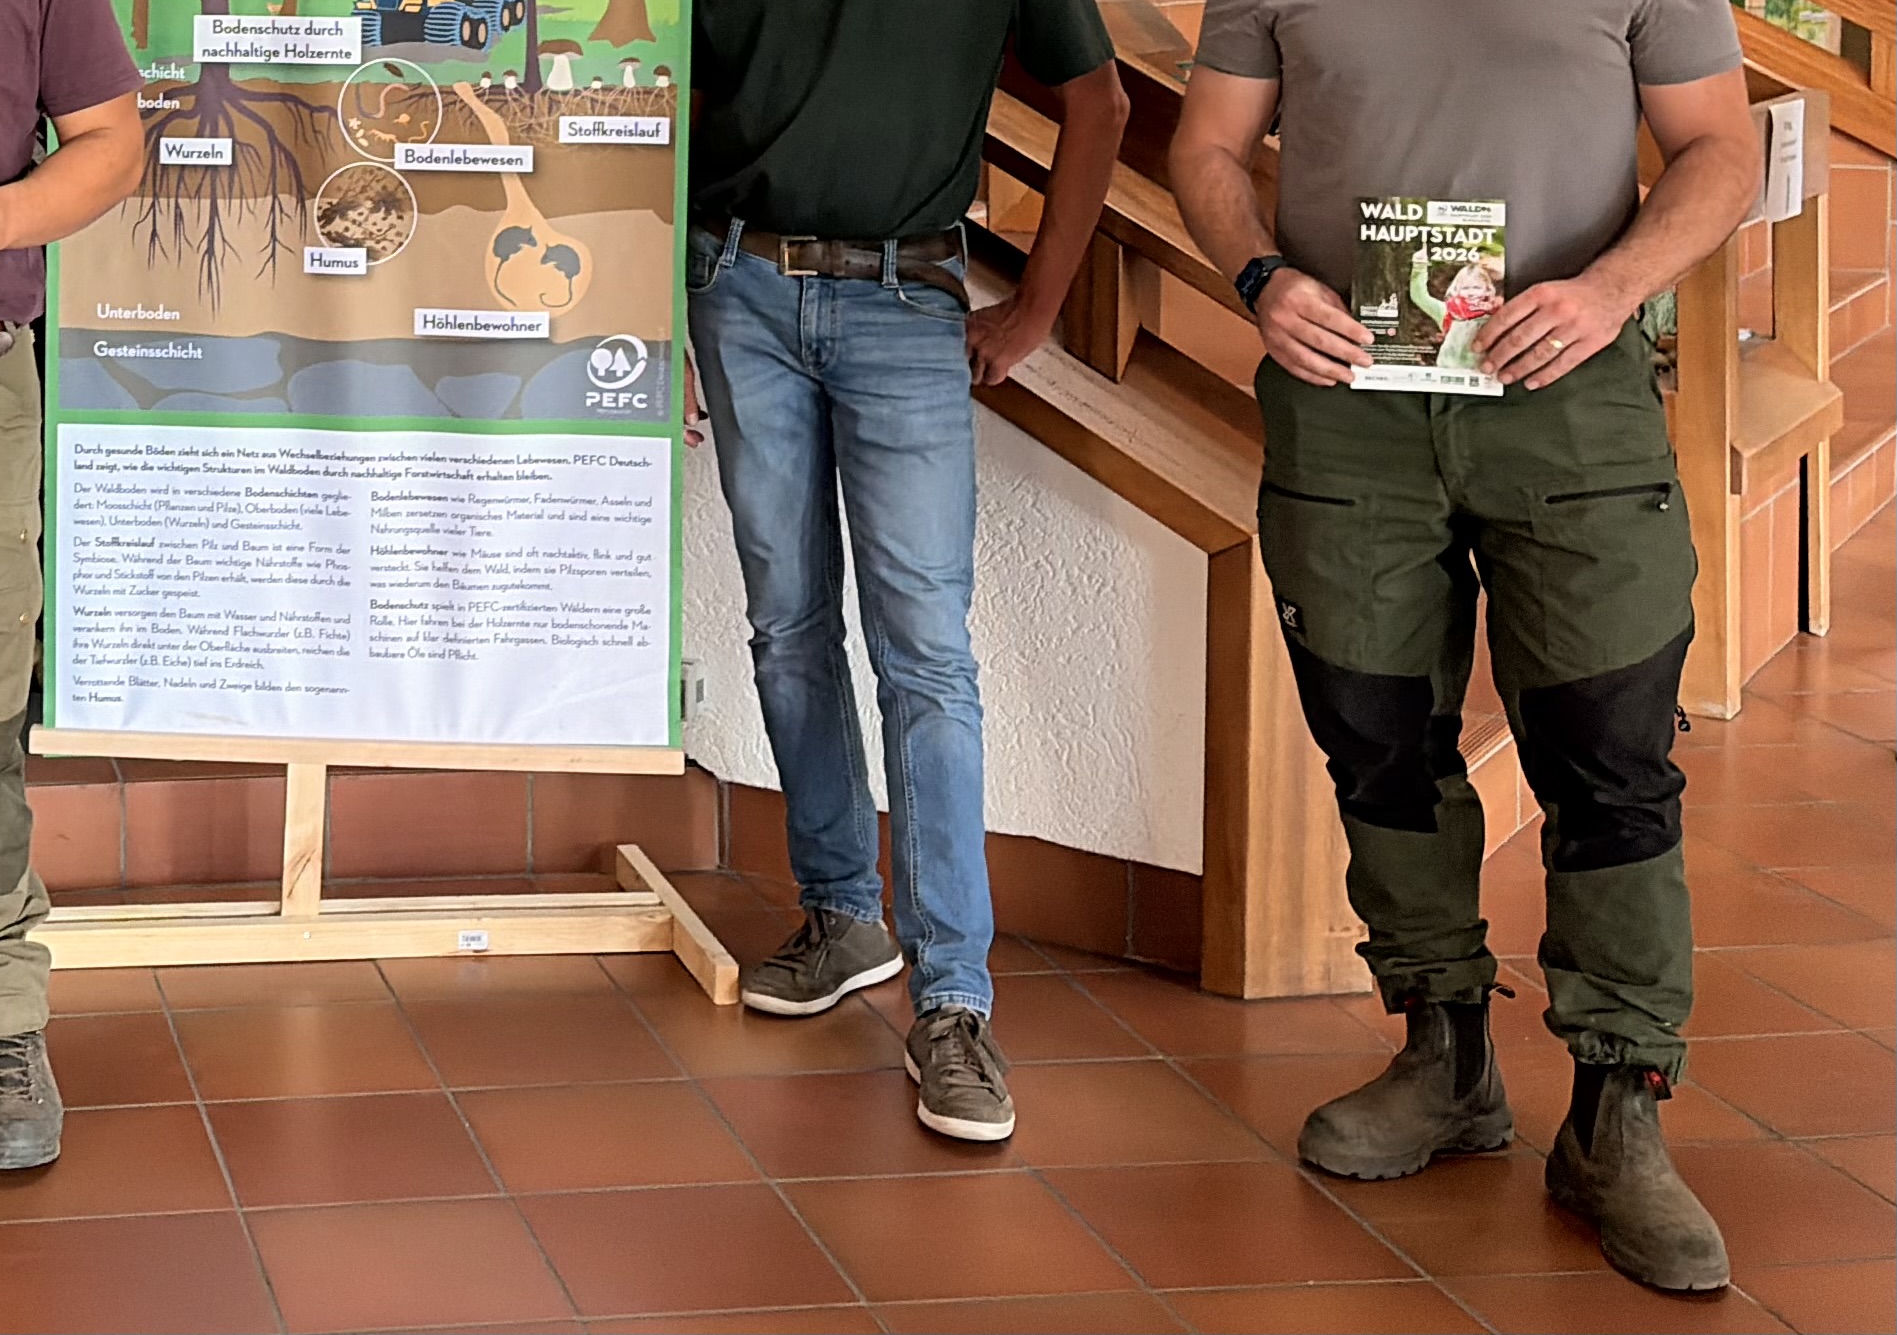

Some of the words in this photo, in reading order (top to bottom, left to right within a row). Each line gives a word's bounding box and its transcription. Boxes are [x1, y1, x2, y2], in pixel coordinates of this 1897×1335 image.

[212, 18, 301, 36] Bodenschutz
[303, 19, 343, 36] durch
[201, 42, 281, 62] nachhaltige
[284, 42, 352, 60] Holzernte
[568, 121, 661, 138] Stoffkreislauf
[164, 143, 224, 159] Wurzeln
[404, 148, 524, 166] Bodenlebewesen
[1360, 202, 1423, 220] WALD
[1360, 224, 1496, 244] HAUPTSTADT
[310, 252, 359, 269] Humus
[1430, 247, 1480, 262] 2026
[96, 303, 180, 320] Unterboden
[423, 313, 542, 332] Höhlenbewohner
[93, 340, 203, 359] Gesteinsschicht
[585, 391, 648, 409] PEFC
